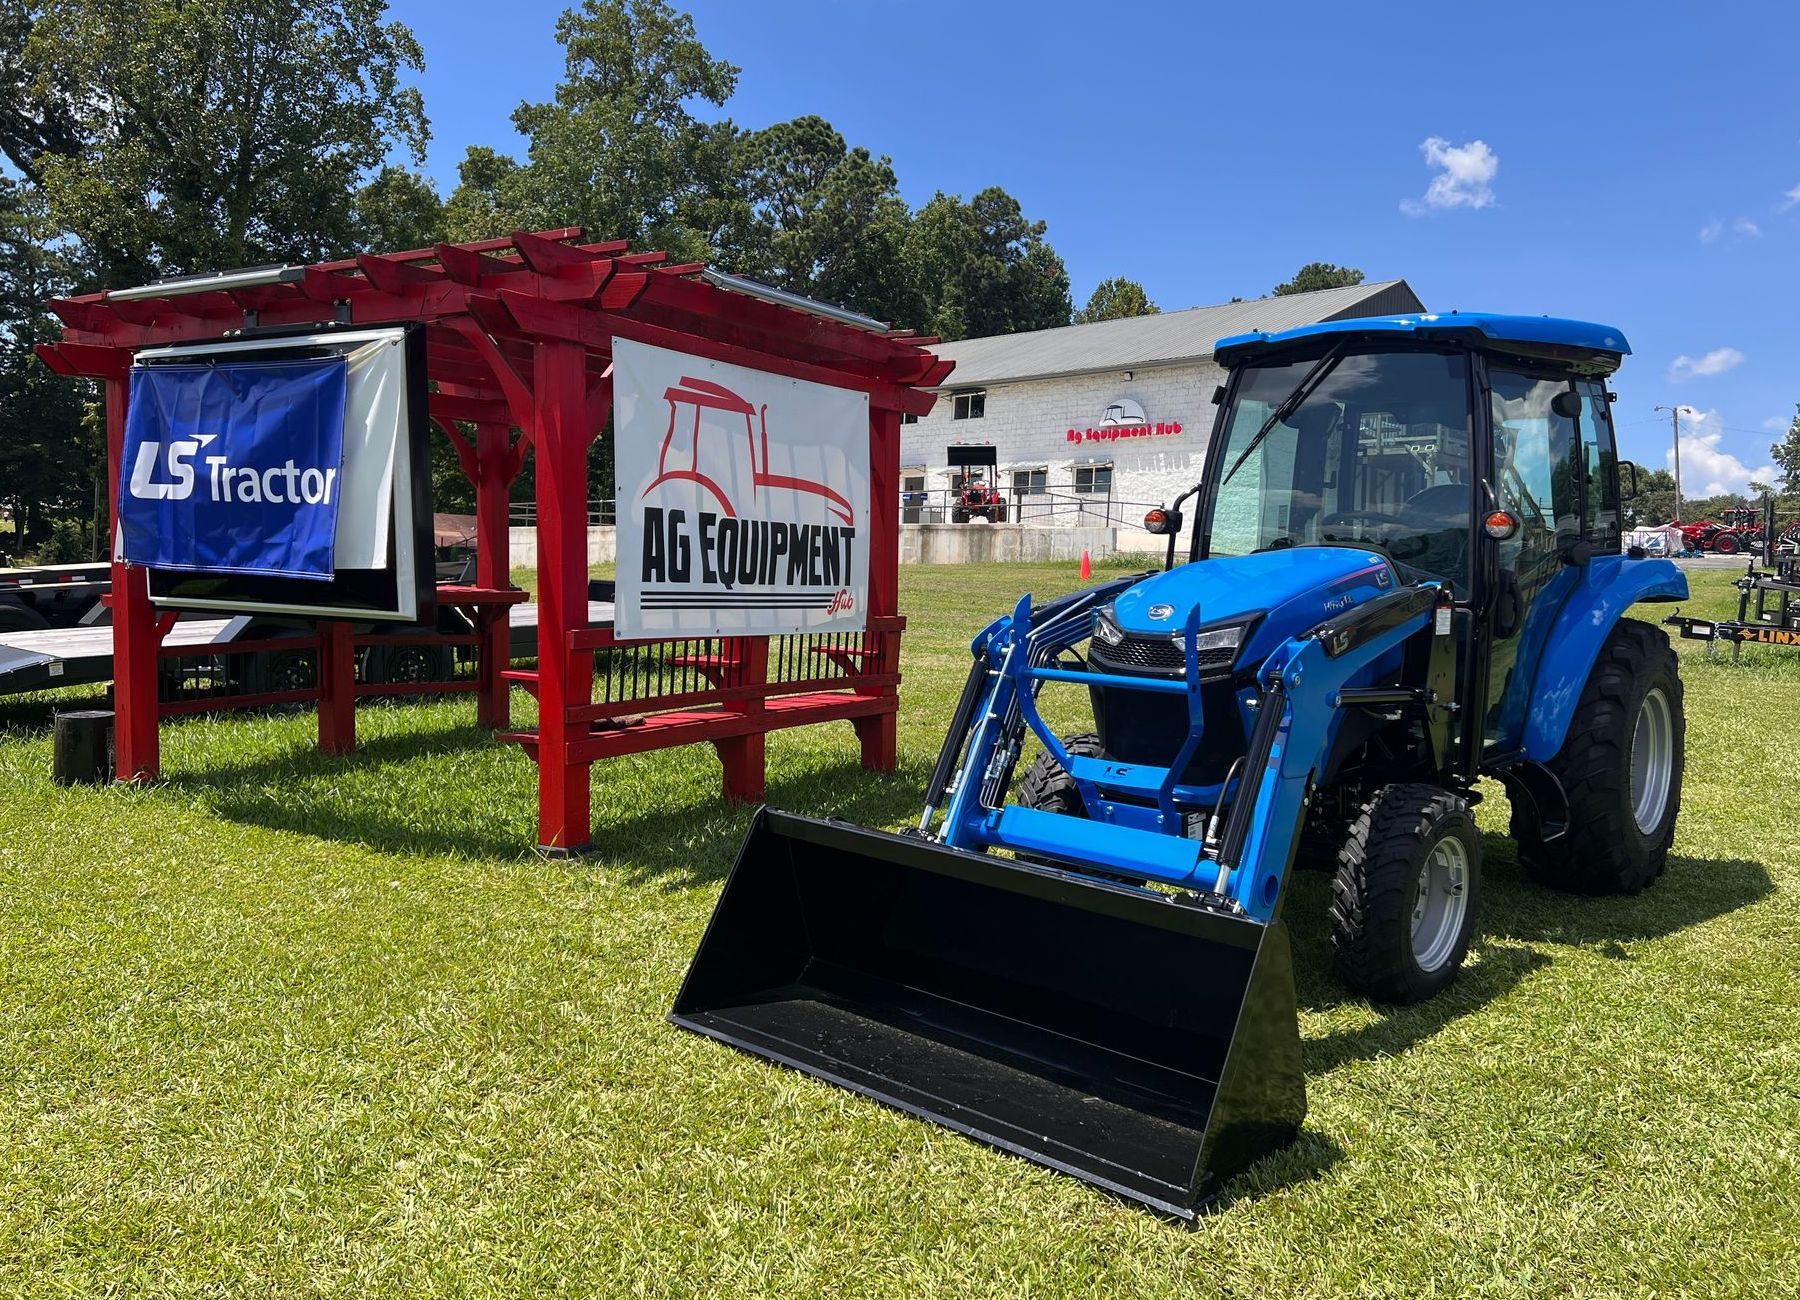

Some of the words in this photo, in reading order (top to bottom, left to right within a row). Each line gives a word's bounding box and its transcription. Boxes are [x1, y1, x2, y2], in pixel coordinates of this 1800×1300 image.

[1066, 429, 1082, 444] Ag
[1085, 423, 1152, 443] Equipment
[1155, 421, 1183, 436] Hub
[130, 436, 207, 500] LS
[205, 455, 336, 505] Tractor
[641, 506, 691, 583] AG
[698, 511, 856, 590] EQUIPMENT
[826, 588, 854, 616] Hub
[1333, 629, 1350, 656] LS
